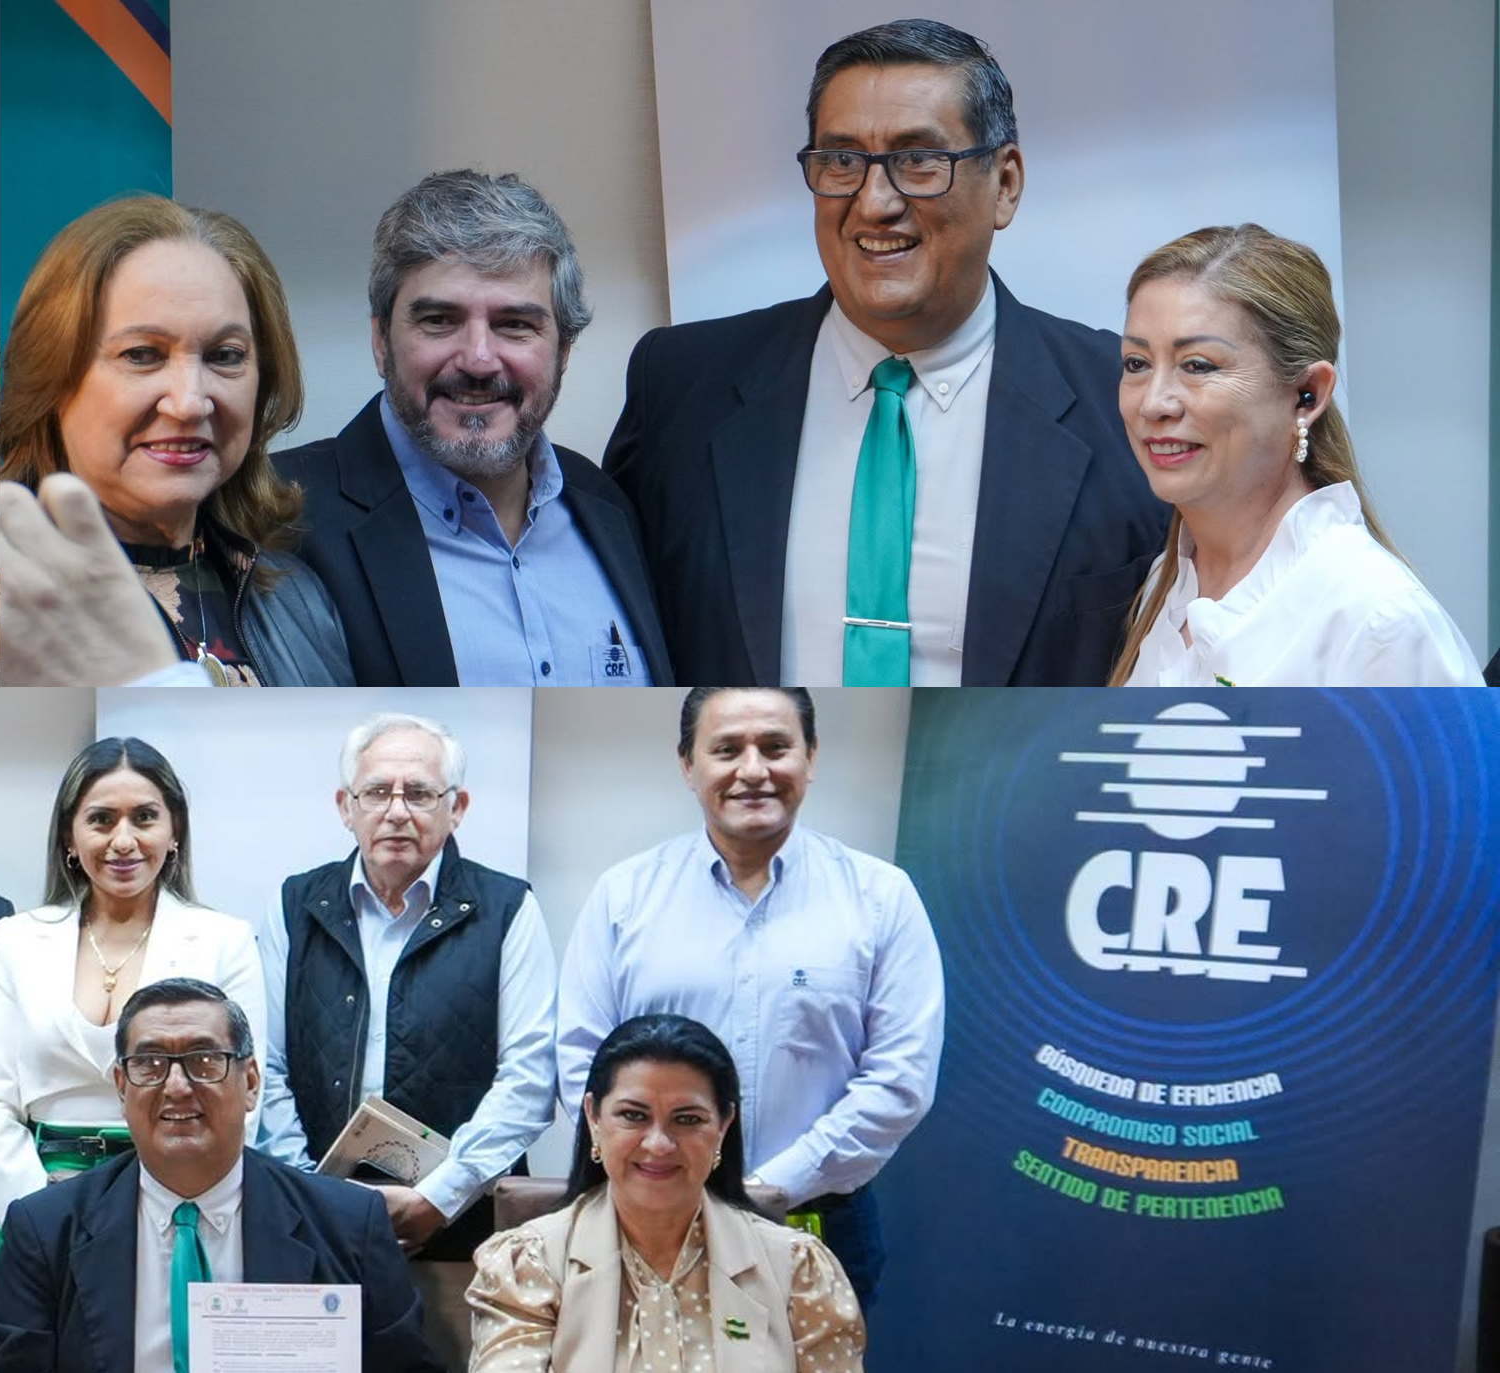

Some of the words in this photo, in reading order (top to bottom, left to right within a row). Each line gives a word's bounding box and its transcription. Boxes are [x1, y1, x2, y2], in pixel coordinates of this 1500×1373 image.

[605, 662, 626, 677] CRE
[1065, 849, 1308, 983] CRE
[1035, 1044, 1136, 1099] BÚSQUEDA
[1137, 1081, 1167, 1104] DE
[1170, 1072, 1283, 1106] EFICIENCIA
[1038, 1087, 1176, 1145] COMPROMISO
[1182, 1120, 1260, 1147] SOCIAL
[1013, 1149, 1097, 1203] SENTIDO
[1101, 1187, 1131, 1213] DE
[1135, 1186, 1284, 1219] PERTENENCIA
[1062, 1136, 1239, 1183] TRANSPARENCIA
[996, 1312, 1017, 1327] La
[1104, 1330, 1126, 1345] de
[1134, 1336, 1209, 1358] nuestra
[1218, 1351, 1272, 1369] gente
